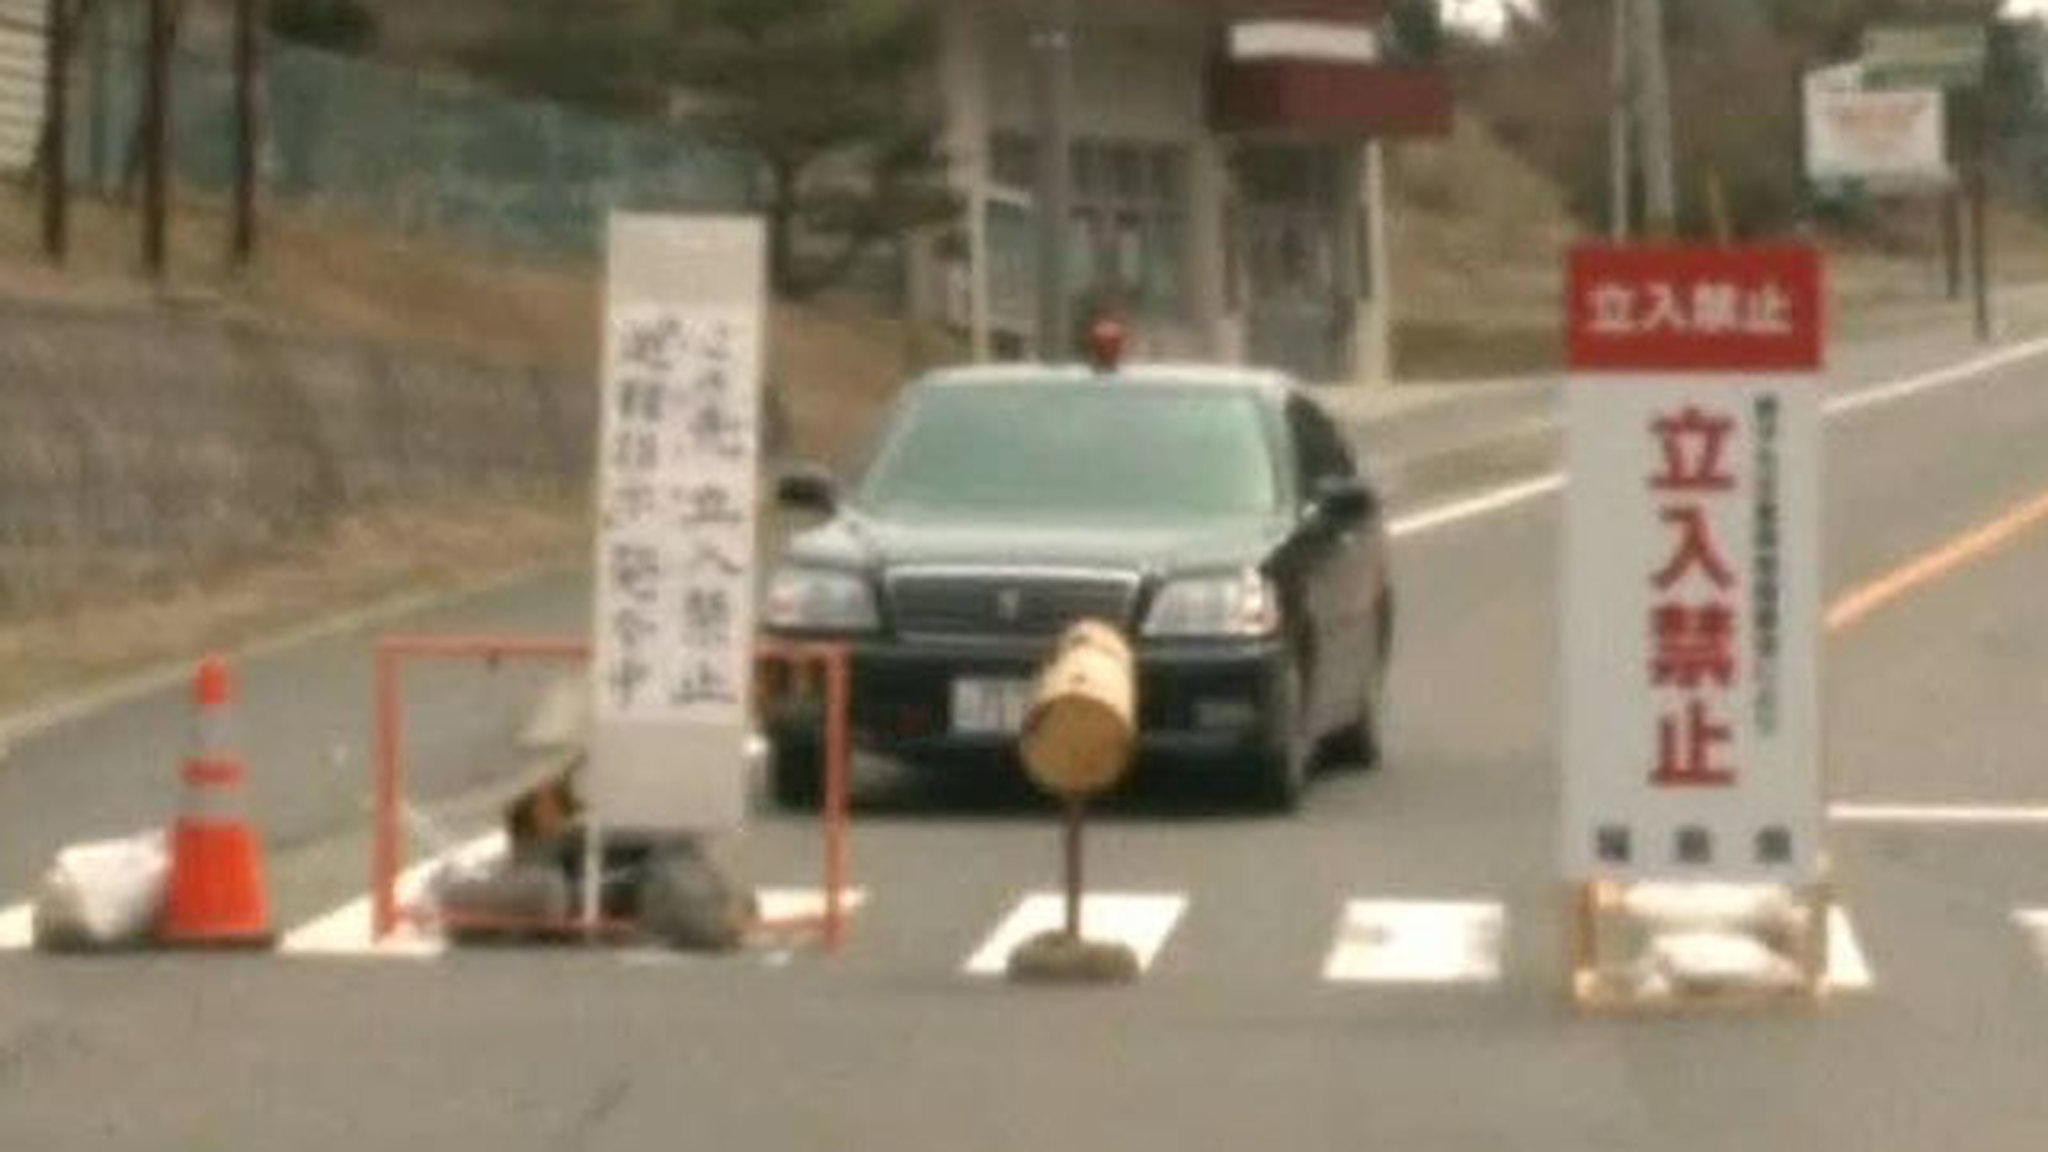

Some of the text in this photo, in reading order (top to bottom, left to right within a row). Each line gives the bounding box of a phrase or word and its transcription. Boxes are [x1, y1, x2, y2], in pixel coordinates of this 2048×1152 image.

[1586, 280, 1793, 333] 立入禁止
[1647, 407, 1736, 789] 立入禁止
